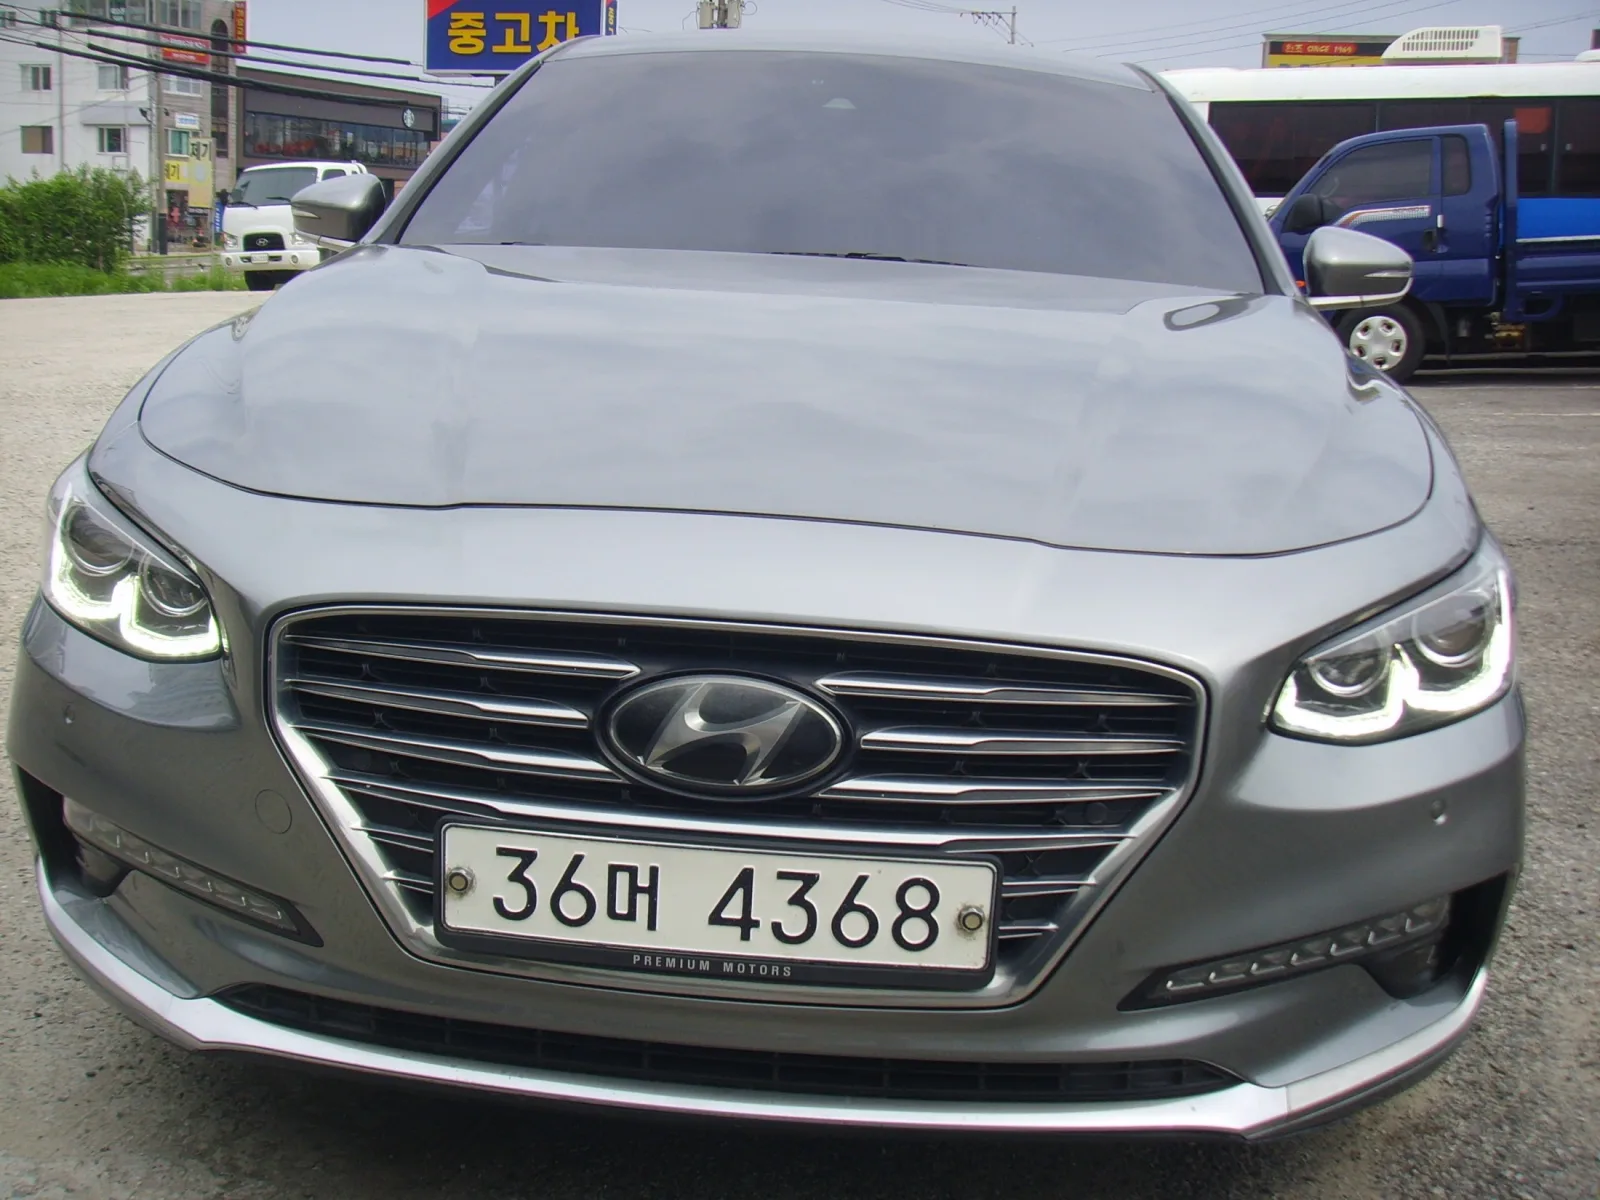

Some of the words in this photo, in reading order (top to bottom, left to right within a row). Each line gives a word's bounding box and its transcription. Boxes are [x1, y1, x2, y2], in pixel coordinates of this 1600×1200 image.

[448, 11, 579, 54] 중고차
[493, 846, 660, 932] 36머
[708, 866, 941, 952] 4368
[632, 953, 712, 972] PREMIUM
[721, 961, 794, 979] MOTORS
